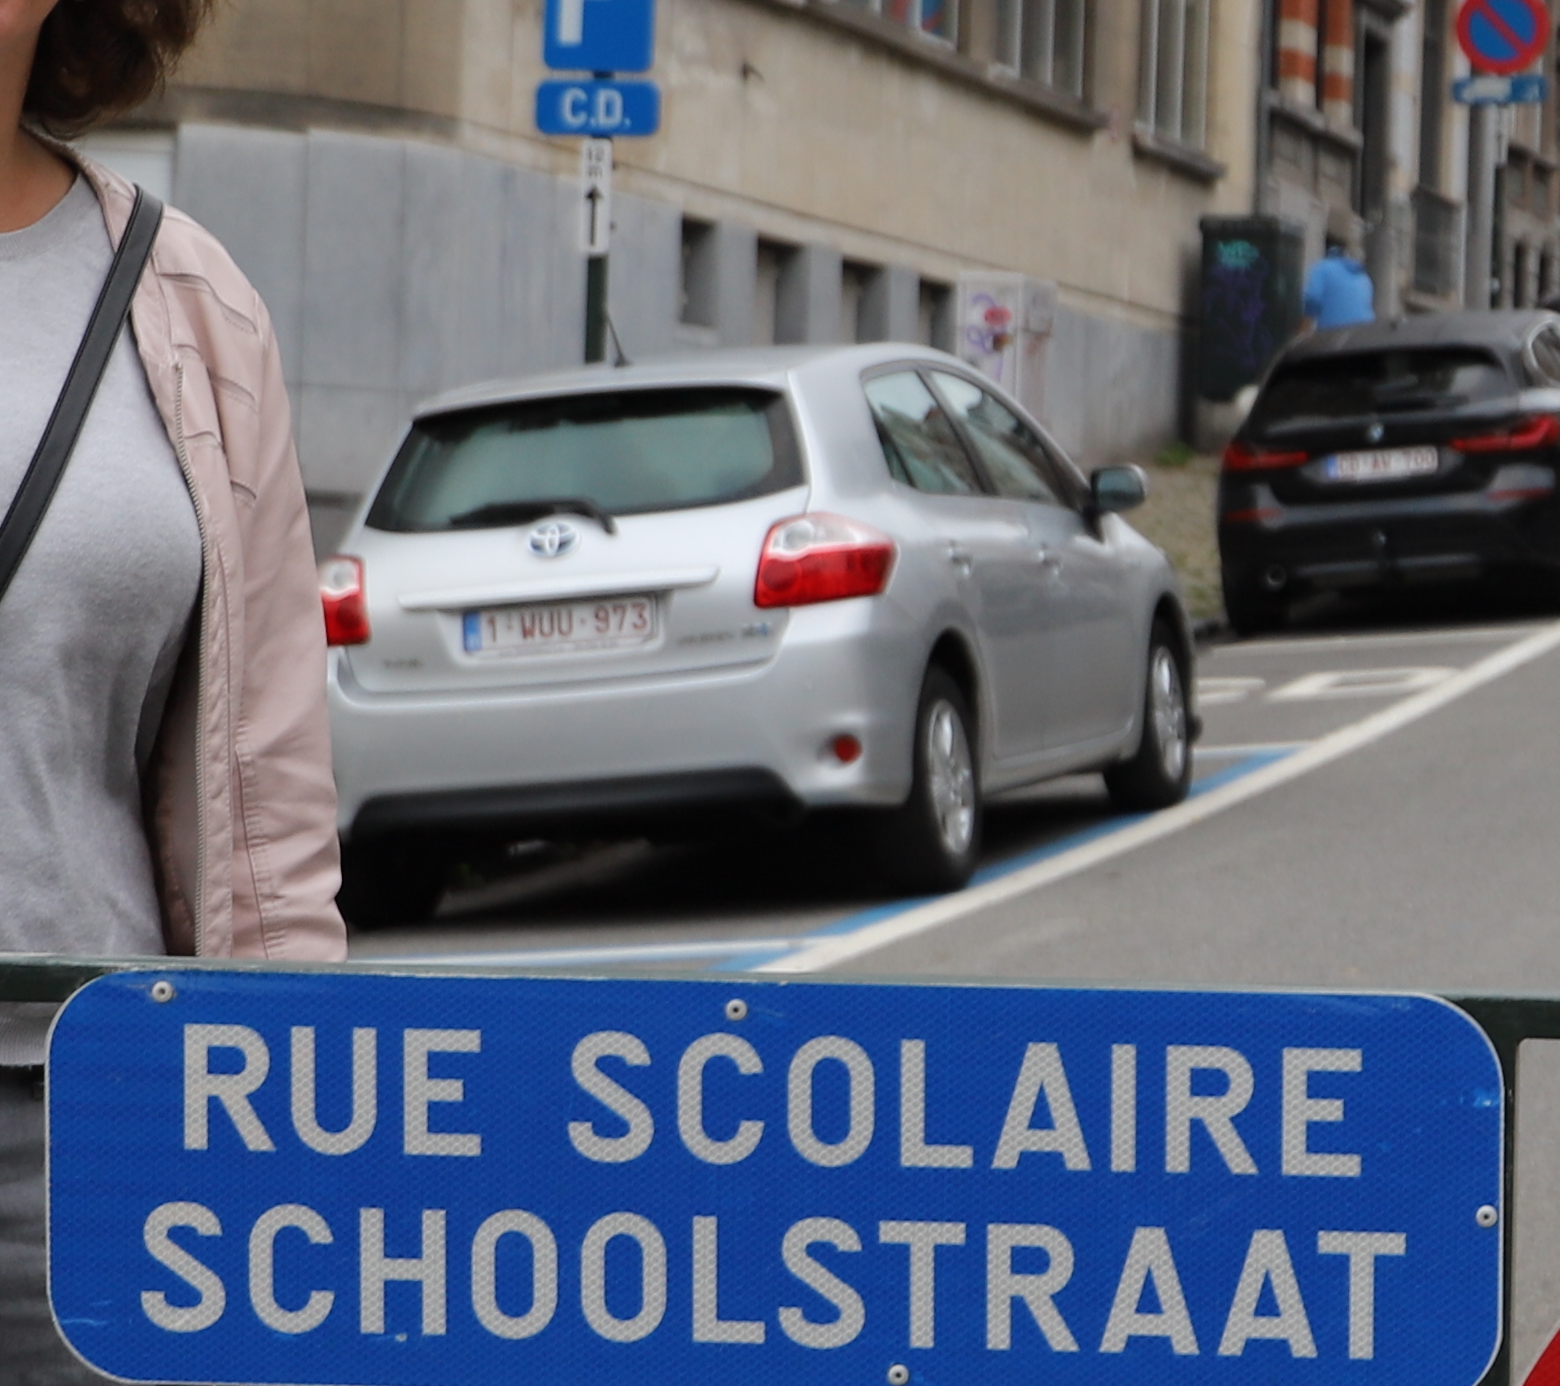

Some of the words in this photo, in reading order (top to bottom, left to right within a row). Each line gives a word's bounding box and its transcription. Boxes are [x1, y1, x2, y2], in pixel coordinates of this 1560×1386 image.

[561, 88, 631, 128] C.D.
[183, 1023, 482, 1156] RUE
[568, 1031, 1362, 1178] SCOLAIRE
[141, 1201, 1407, 1359] SCHOOLSTRAAT
